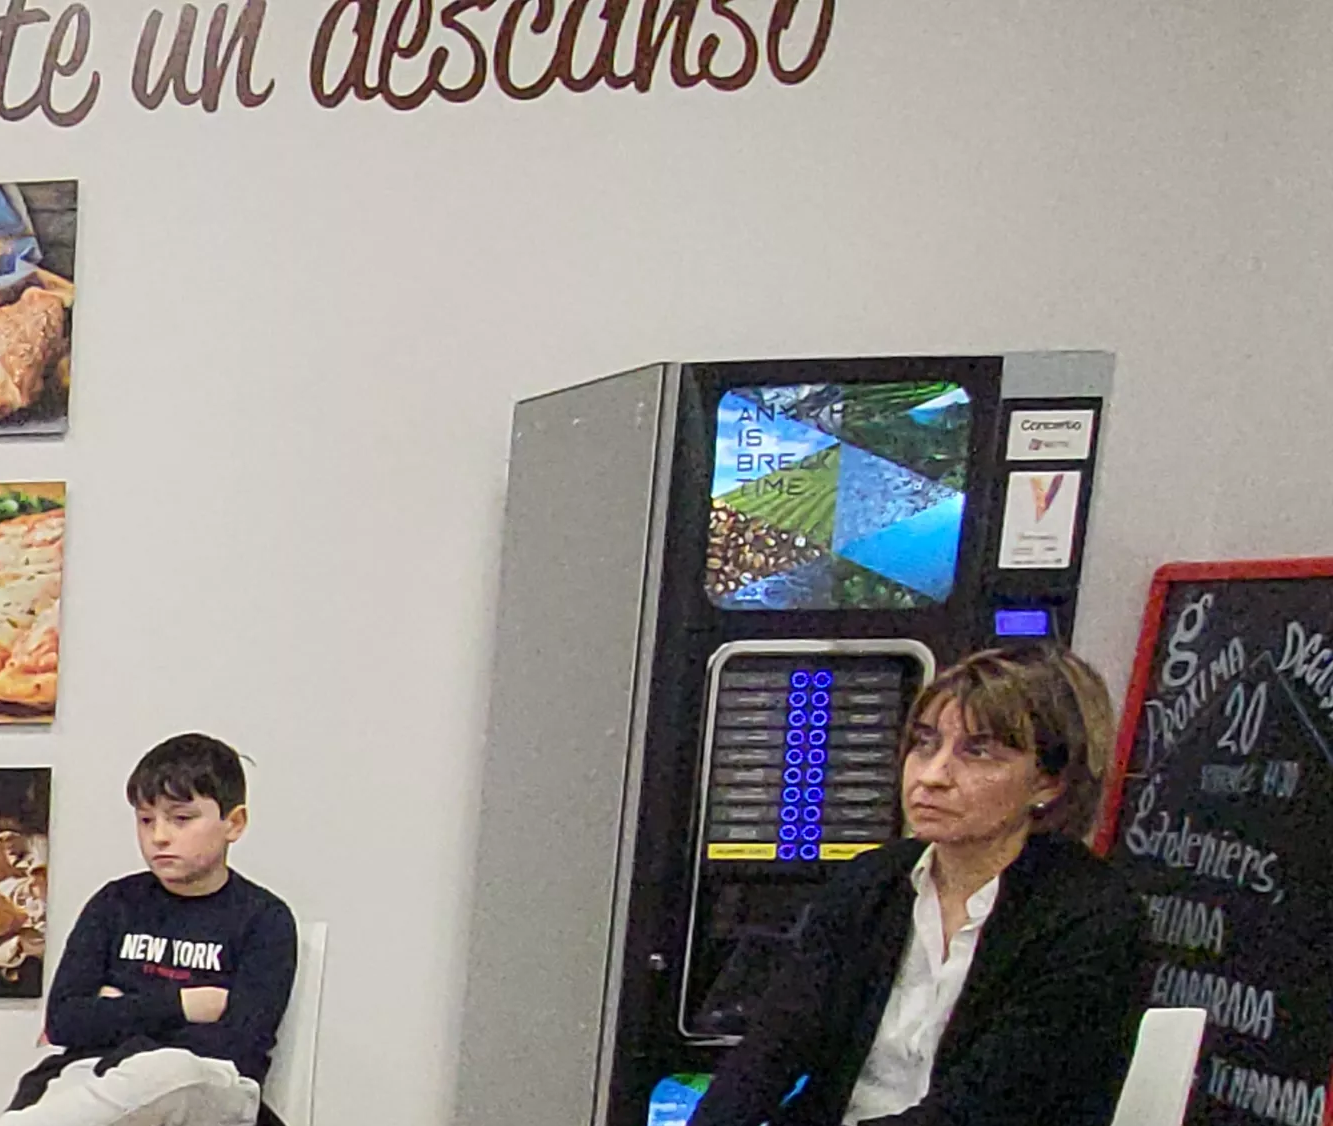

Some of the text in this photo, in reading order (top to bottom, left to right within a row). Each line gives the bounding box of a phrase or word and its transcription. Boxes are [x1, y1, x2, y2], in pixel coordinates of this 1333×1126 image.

[132, 0, 276, 112] un
[738, 429, 762, 447] IS
[1218, 681, 1268, 755] 20
[119, 933, 168, 963] NEW
[172, 937, 223, 972] YORK
